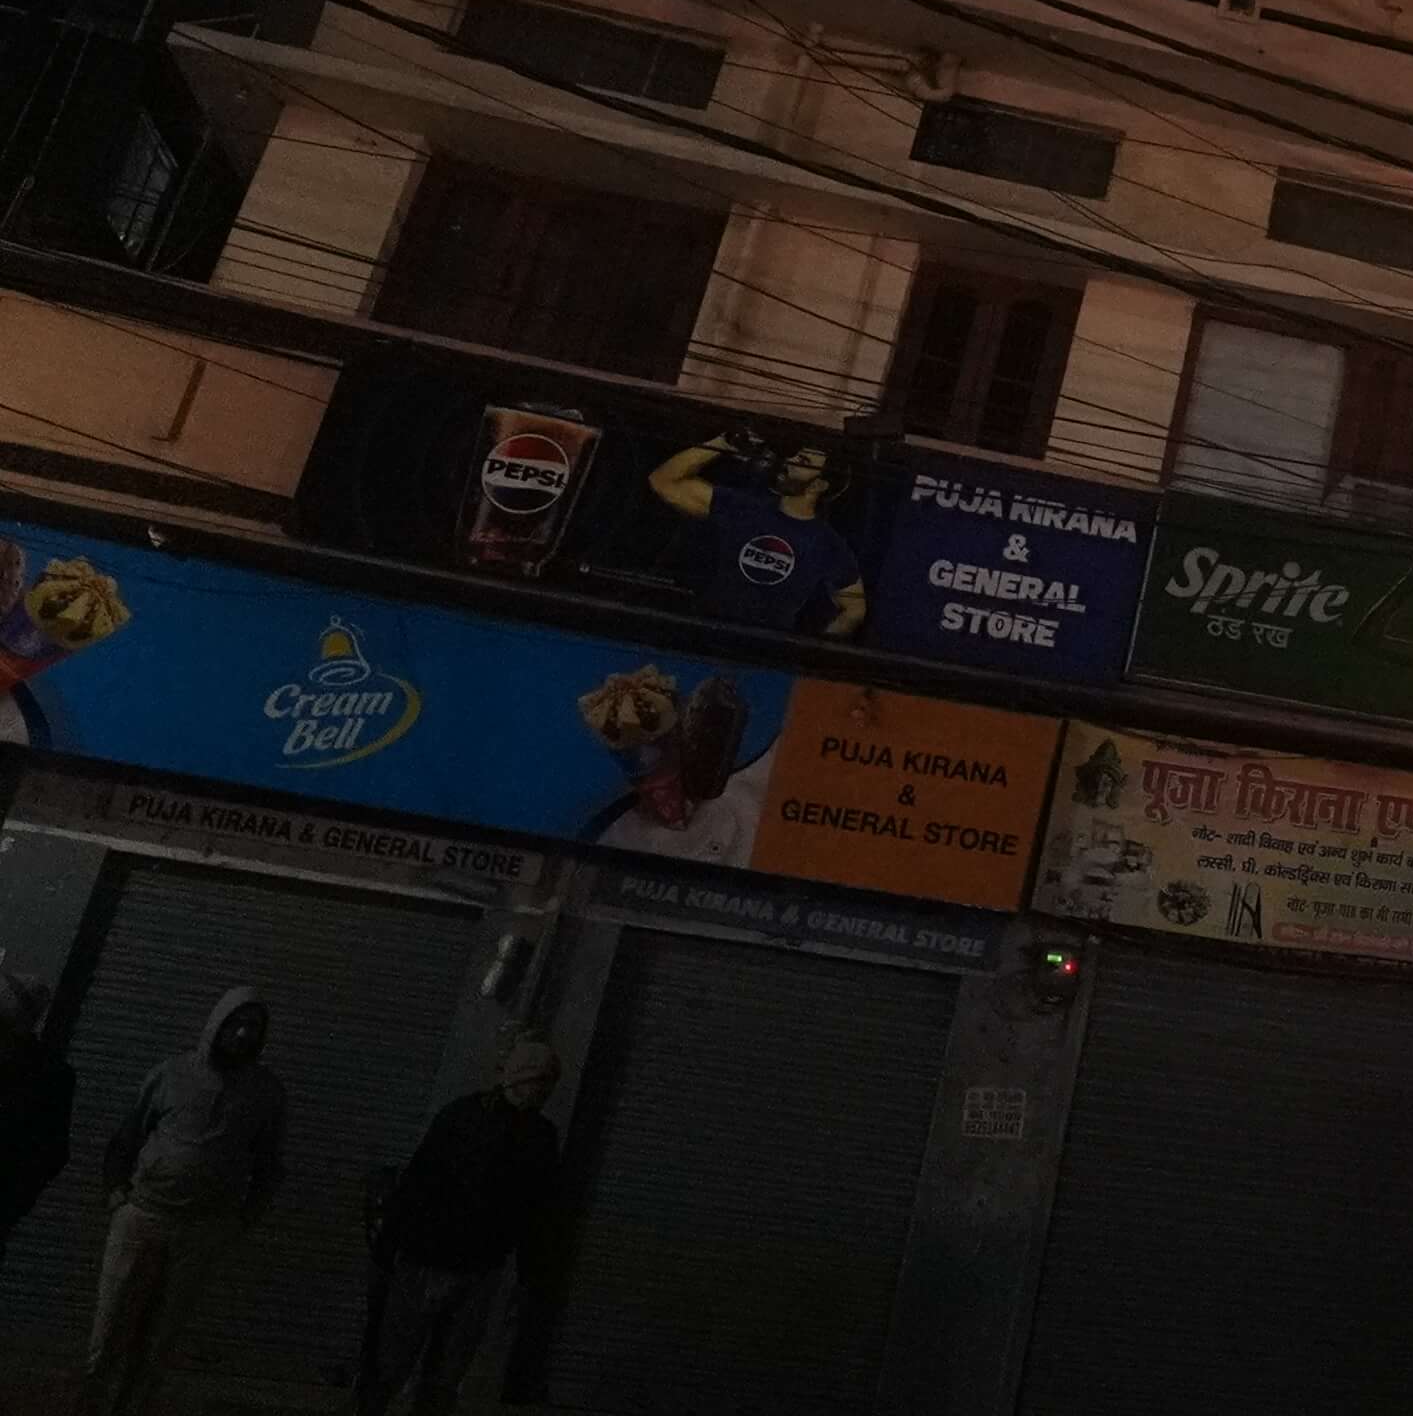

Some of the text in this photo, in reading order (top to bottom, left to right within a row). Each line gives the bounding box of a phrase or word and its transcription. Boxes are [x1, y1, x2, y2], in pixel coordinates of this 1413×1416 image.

[486, 458, 566, 491] PEPSI
[911, 475, 1137, 544] PUJA KIRANA
[743, 547, 792, 574] PEPSI
[1003, 534, 1031, 562] &
[928, 560, 1087, 613] GENERAL
[1164, 546, 1350, 623] Sprite
[939, 601, 1058, 648] STORE
[1206, 608, 1294, 649] ठंड रख
[263, 683, 396, 720] Cream
[282, 716, 364, 756] Bell
[820, 737, 1009, 788] PUJA KIRANA
[897, 784, 917, 806] &
[1141, 760, 1227, 825] पूजा
[1234, 762, 1370, 834] किराना
[129, 794, 522, 876] PUJA KIRANA & GENERAL STORE
[780, 799, 1019, 856] GENERAL STORE
[621, 876, 678, 904] PUJA
[685, 888, 775, 922] KIRANA
[807, 910, 910, 944] GENERAL
[912, 929, 985, 957] STORE
